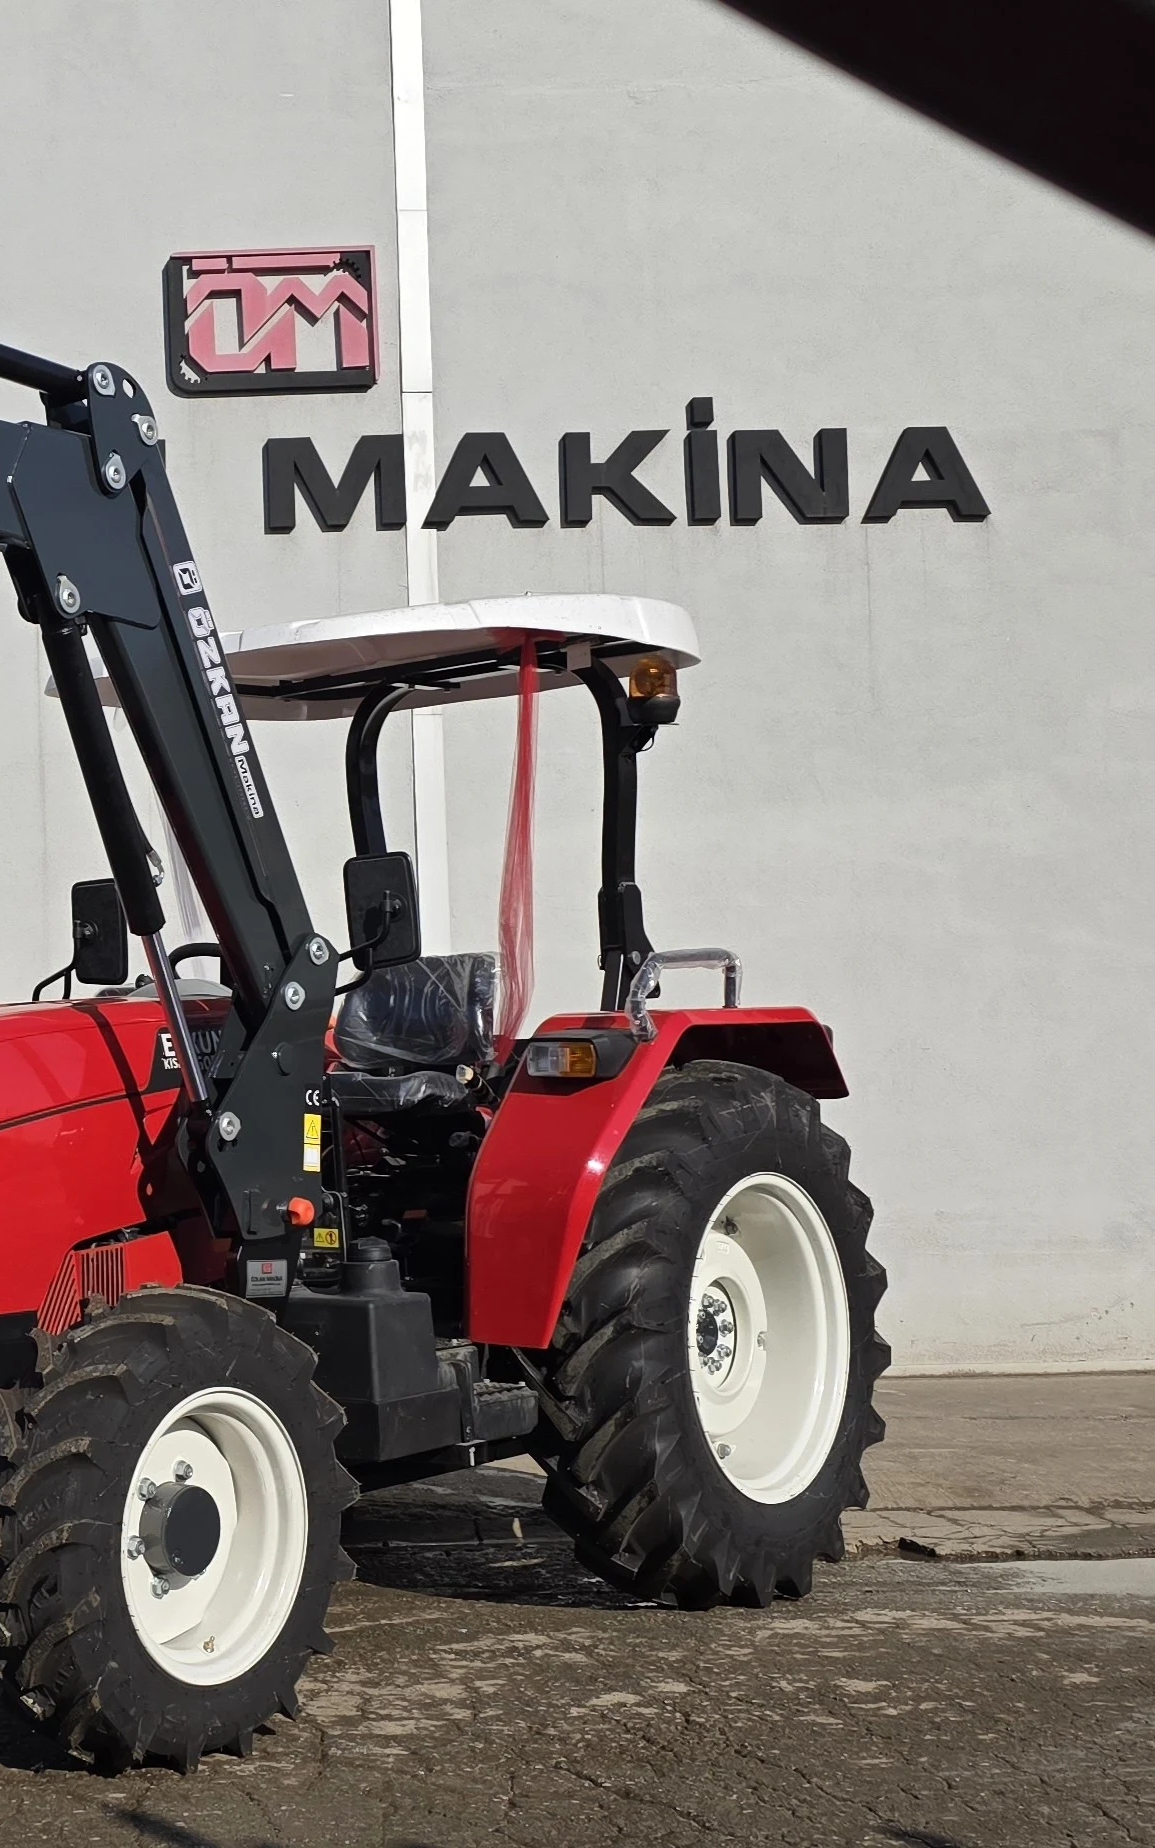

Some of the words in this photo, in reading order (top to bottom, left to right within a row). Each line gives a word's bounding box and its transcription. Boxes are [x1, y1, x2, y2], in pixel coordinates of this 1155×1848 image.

[262, 397, 991, 535] MAKİNA
[188, 606, 250, 756] ÖZKAN
[237, 757, 261, 816] Makina
[305, 1089, 320, 1107] CE
